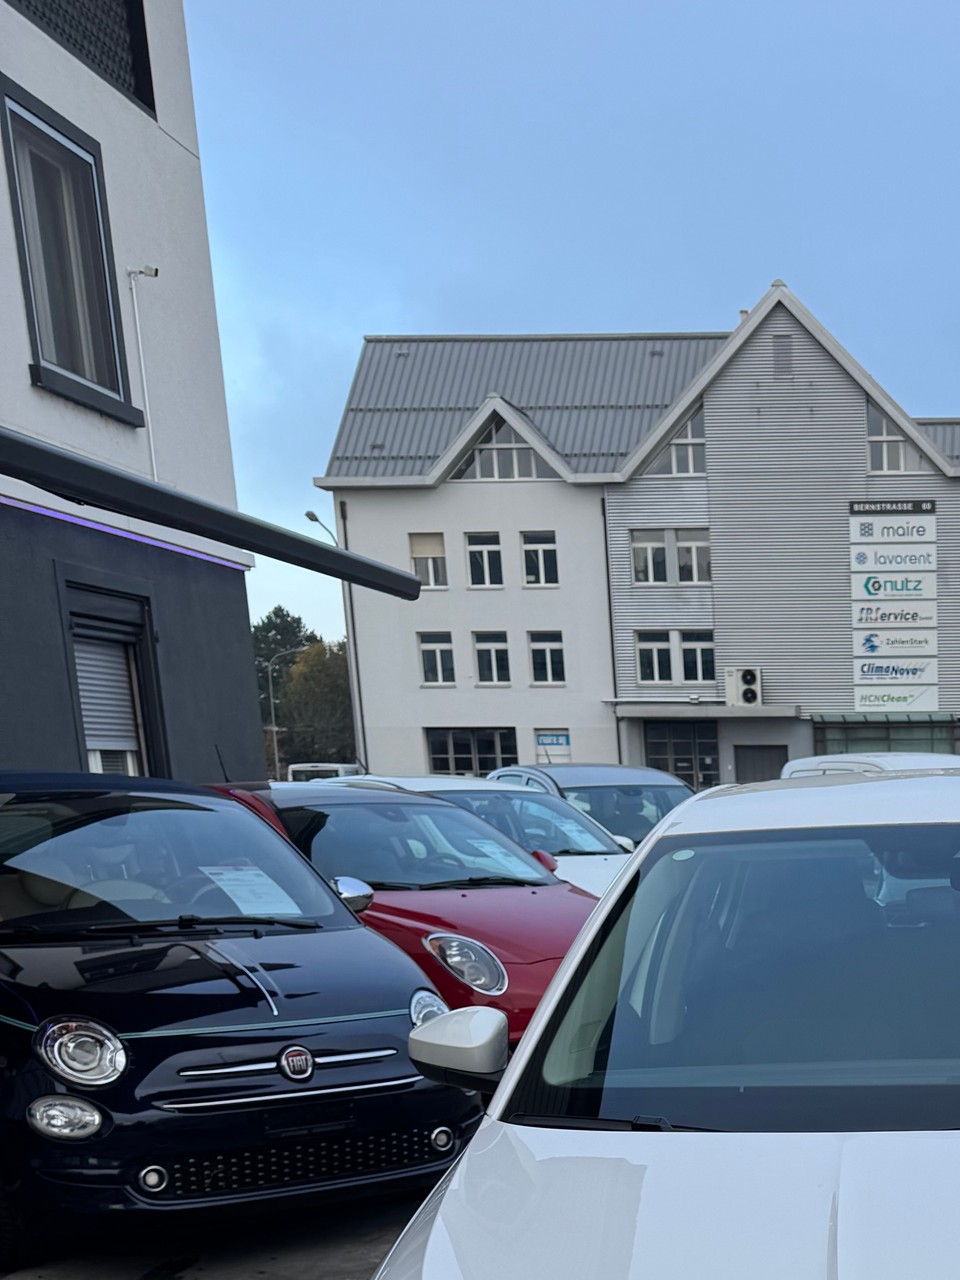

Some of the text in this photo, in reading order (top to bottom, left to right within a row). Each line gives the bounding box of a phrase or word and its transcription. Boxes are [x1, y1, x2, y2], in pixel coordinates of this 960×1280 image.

[853, 502, 914, 512] BERNSTRASSE
[880, 522, 927, 537] maire
[874, 552, 932, 565] lavorent
[885, 638, 929, 646] ZahlenStark
[860, 663, 918, 676] ClimaNova
[860, 693, 909, 703] HCNClean
[288, 1056, 307, 1072] FIAT
